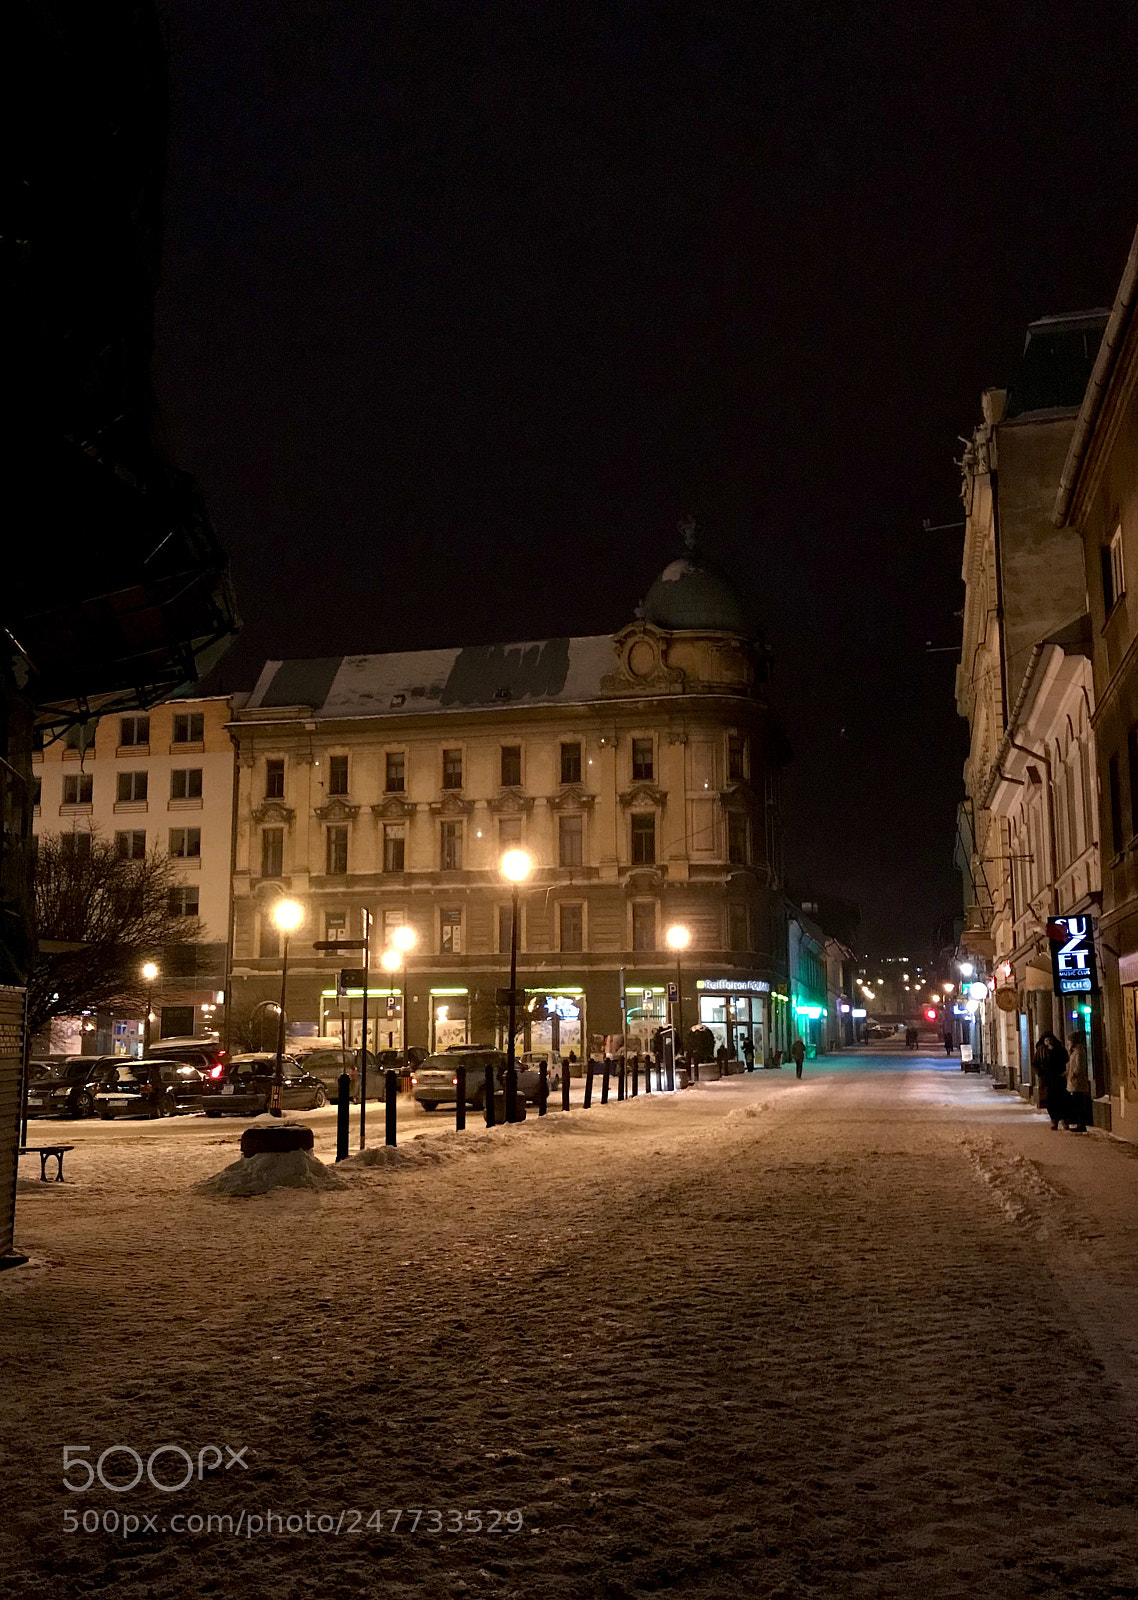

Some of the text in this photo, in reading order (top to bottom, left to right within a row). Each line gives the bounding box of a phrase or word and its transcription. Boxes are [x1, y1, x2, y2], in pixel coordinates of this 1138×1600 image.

[1062, 981, 1082, 989] LECH
[670, 985, 677, 994] P
[645, 990, 652, 999] P
[388, 997, 395, 1005] P
